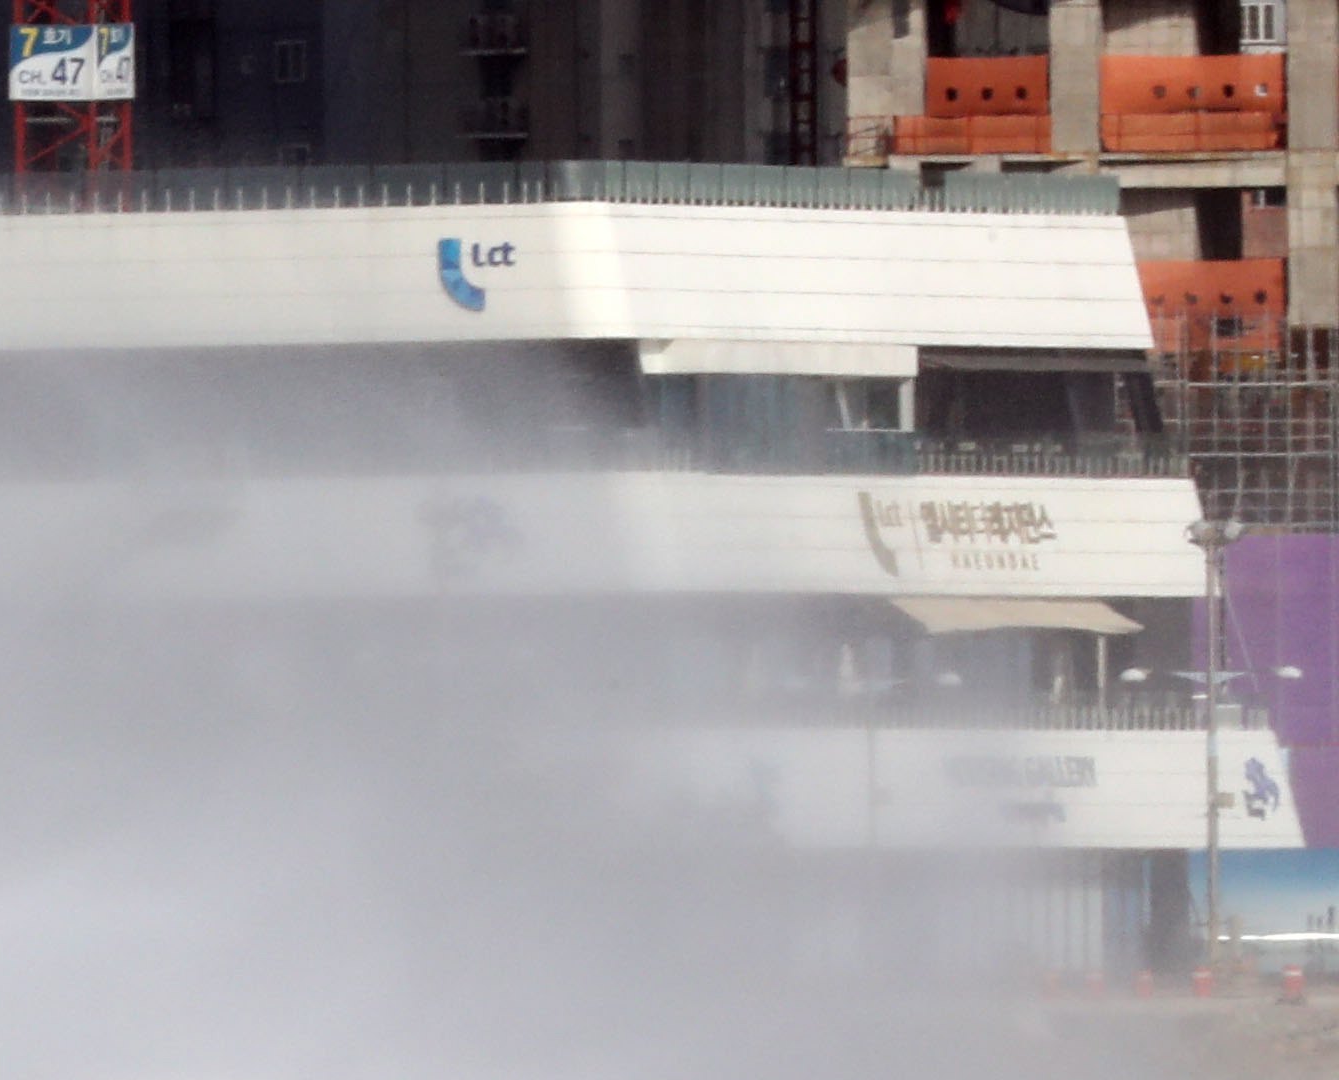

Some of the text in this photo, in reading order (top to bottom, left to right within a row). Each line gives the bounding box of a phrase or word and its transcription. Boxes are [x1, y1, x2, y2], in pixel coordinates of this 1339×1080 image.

[19, 26, 71, 58] 7 호기
[51, 56, 85, 85] 47
